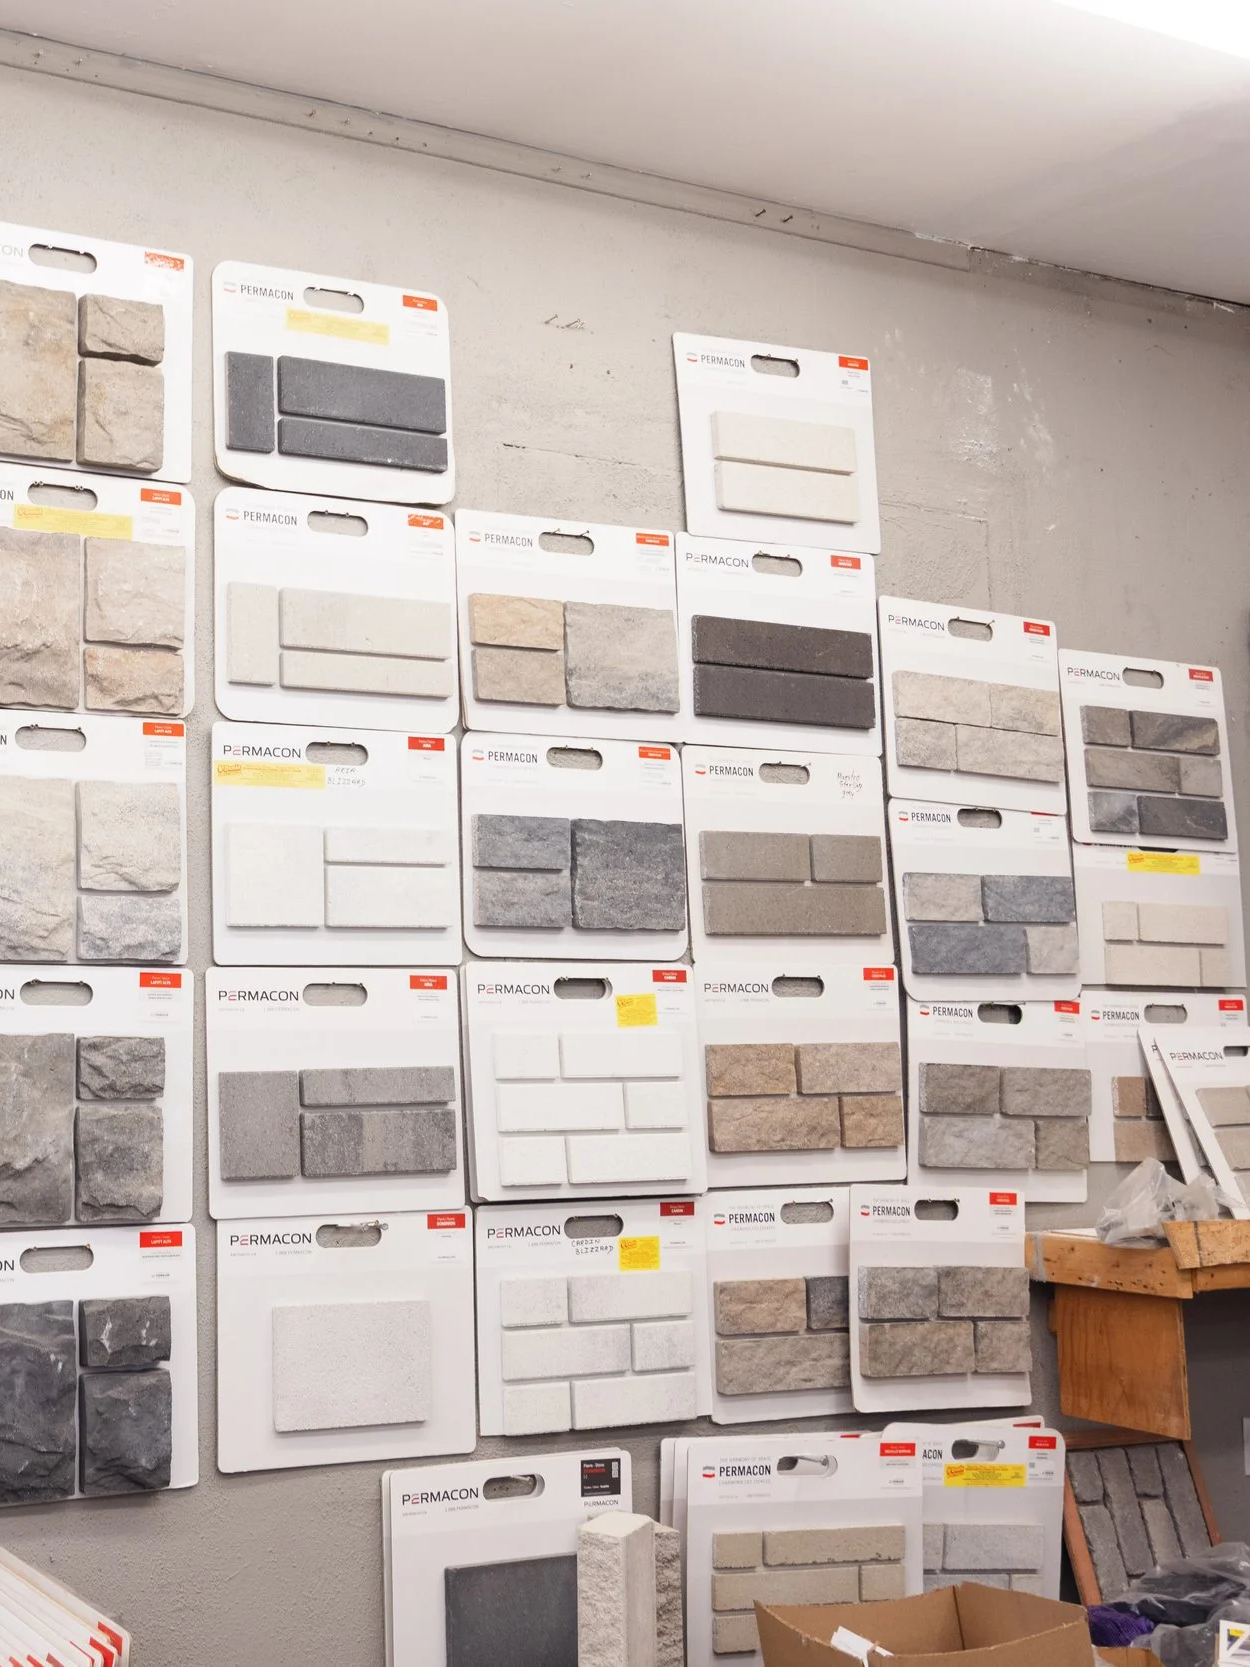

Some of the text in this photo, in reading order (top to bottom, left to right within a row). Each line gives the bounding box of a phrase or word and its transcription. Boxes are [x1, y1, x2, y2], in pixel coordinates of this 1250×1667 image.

[240, 284, 294, 301] PERMACON
[701, 354, 745, 368] PERMACON
[243, 510, 298, 526] PERMACON
[484, 533, 533, 548] PERMACON
[685, 552, 749, 569] PERMACON
[888, 614, 945, 631] PERMACON
[1067, 667, 1120, 681] PERMACON
[222, 744, 302, 759] PERMACON
[488, 750, 538, 764] PERMACON
[709, 765, 754, 777] PERMACON
[911, 812, 951, 823] PERMACON
[477, 983, 550, 995] PERMACON
[703, 983, 769, 993] PERMACON
[218, 990, 299, 1002] PERMACON
[932, 1006, 973, 1018] PERMACON
[1102, 1011, 1140, 1021] PERMACON
[1169, 1052, 1224, 1061] PERMACON
[872, 1205, 911, 1217] PERMACON
[729, 1212, 775, 1224] PERMACON
[487, 1224, 561, 1239] PERMACON
[230, 1233, 312, 1246] PERMACON
[922, 1449, 943, 1460] ACON
[719, 1464, 771, 1477] PERMACON
[402, 1487, 479, 1506] PERMACON
